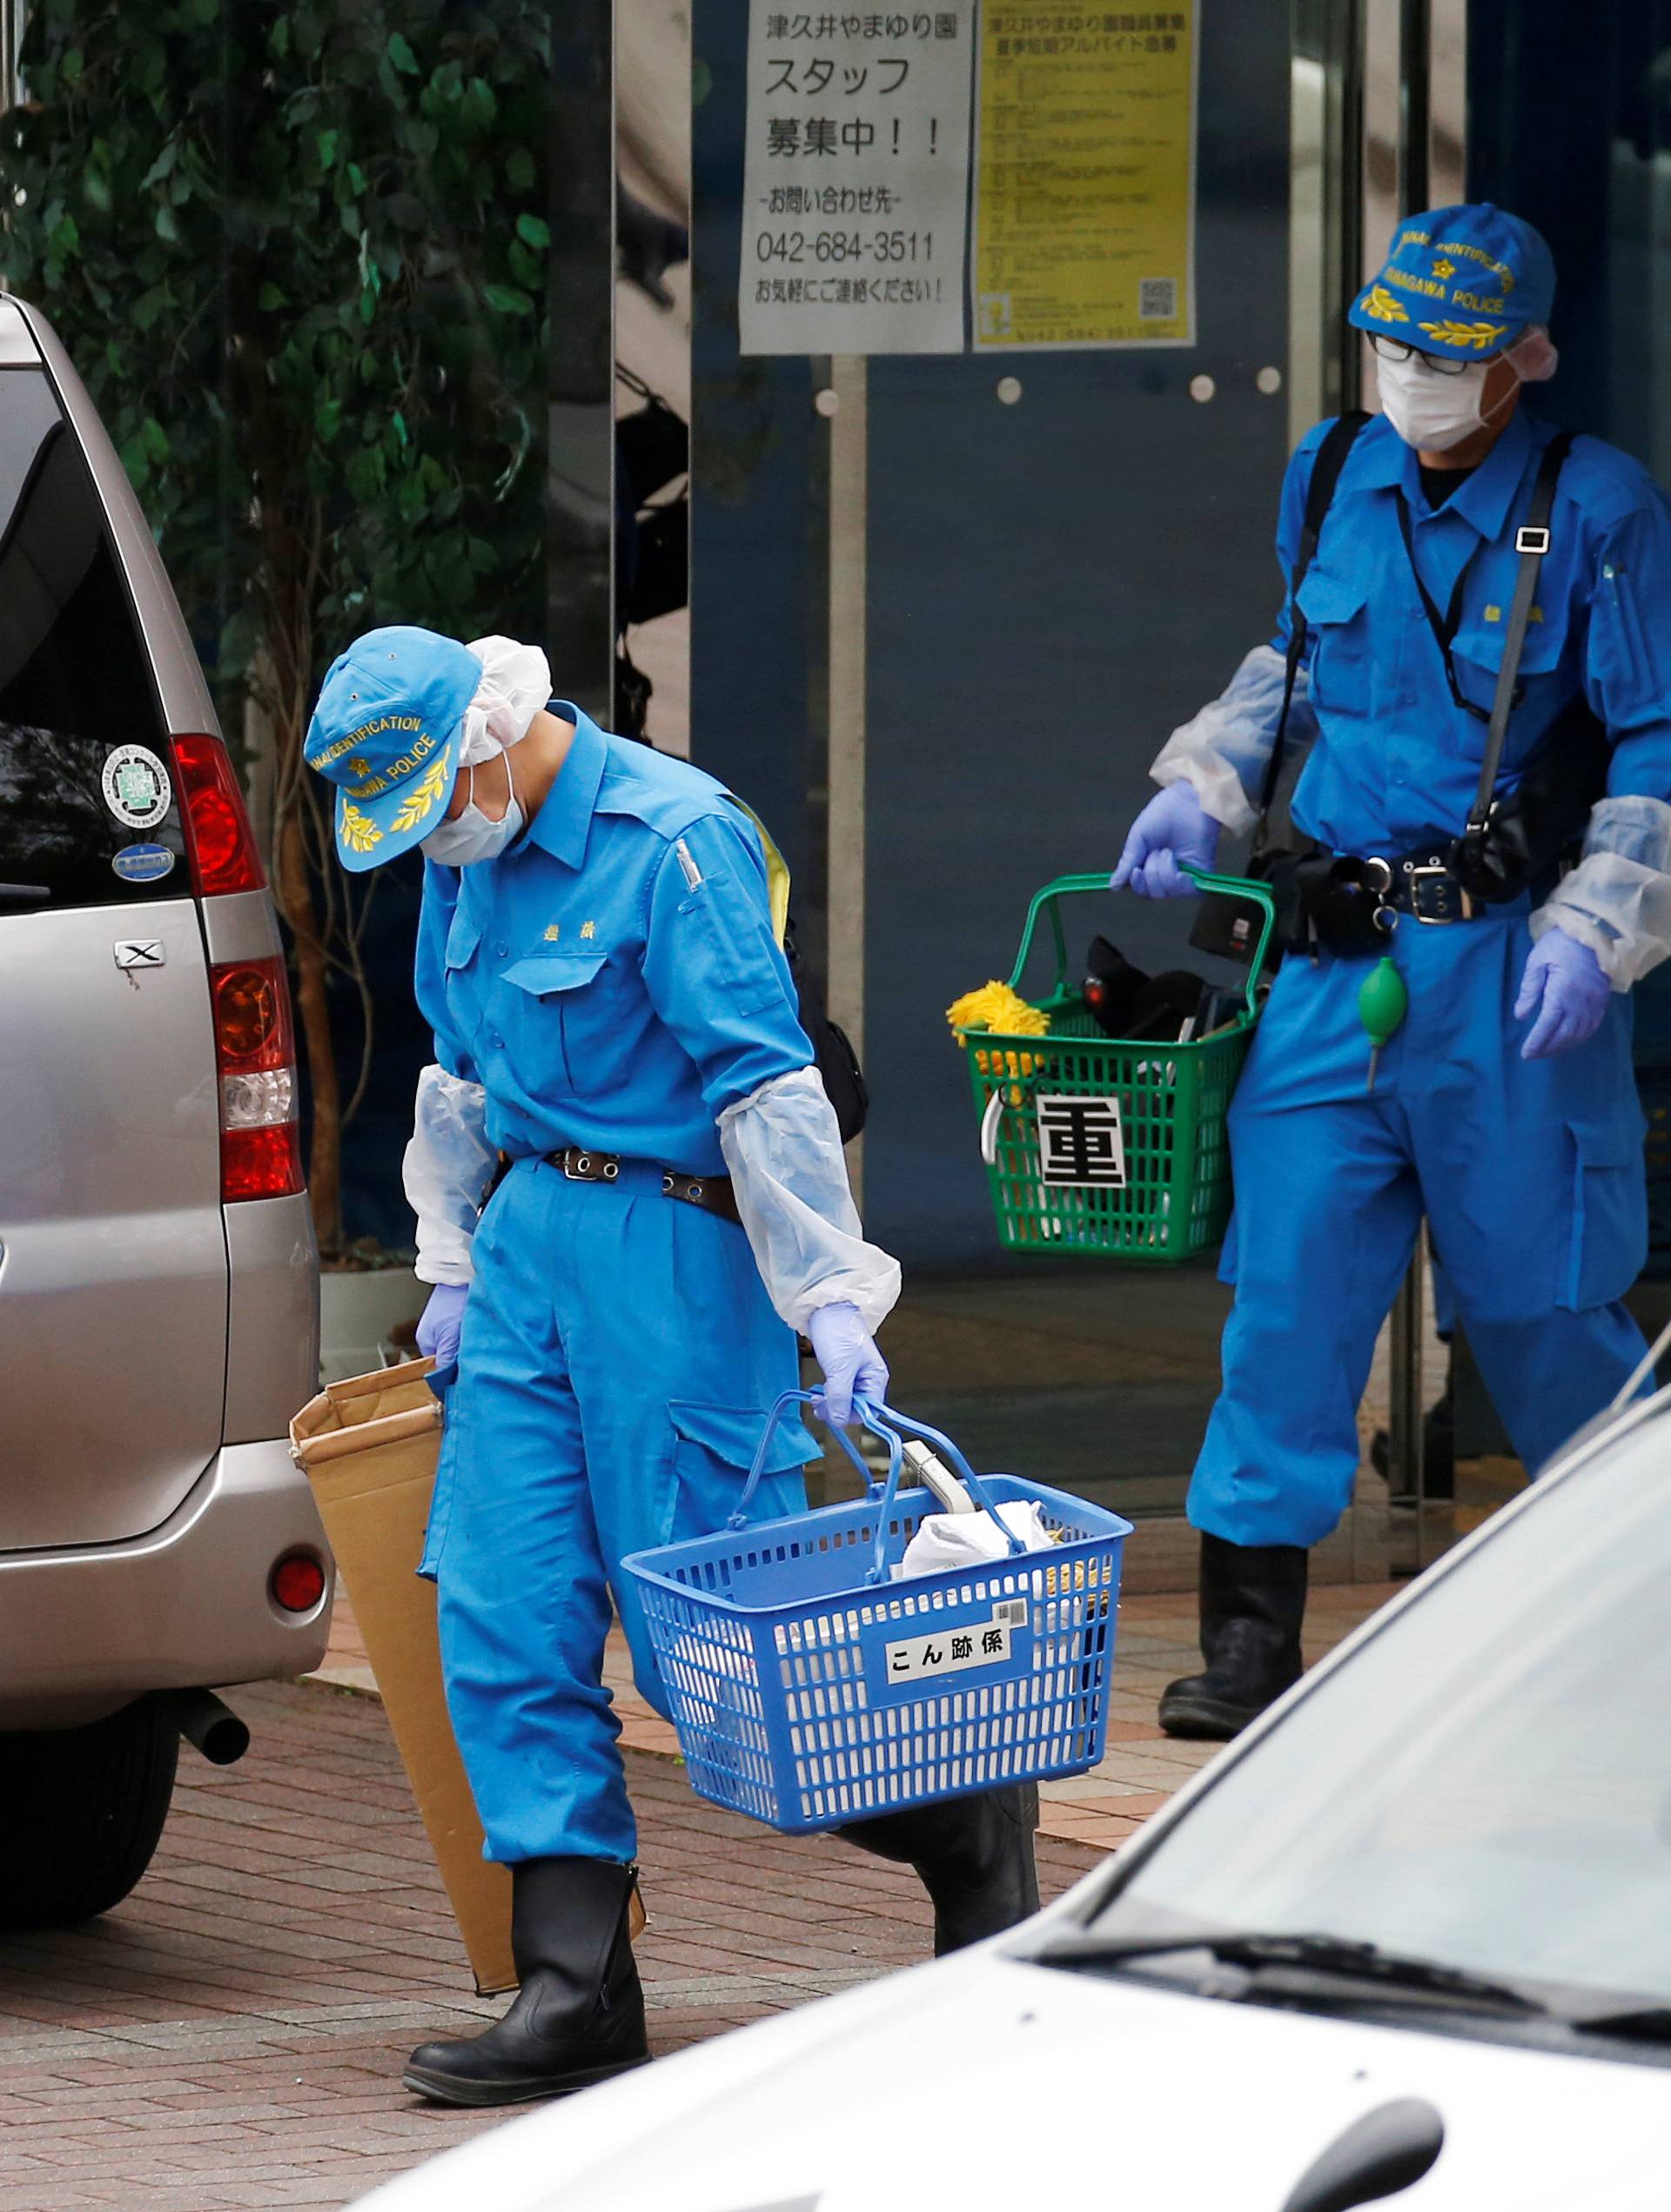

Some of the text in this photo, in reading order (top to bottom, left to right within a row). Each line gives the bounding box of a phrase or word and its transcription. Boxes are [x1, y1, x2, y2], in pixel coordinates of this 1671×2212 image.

[766, 13, 956, 40] 津久井やまゆり園
[765, 58, 909, 95] スタッフ
[756, 231, 933, 263] 042-684-3511
[1453, 289, 1505, 315] POLICE
[386, 732, 436, 780] POLICE
[1040, 1103, 1123, 1184] 重
[892, 1629, 1003, 1672] こん跡係
